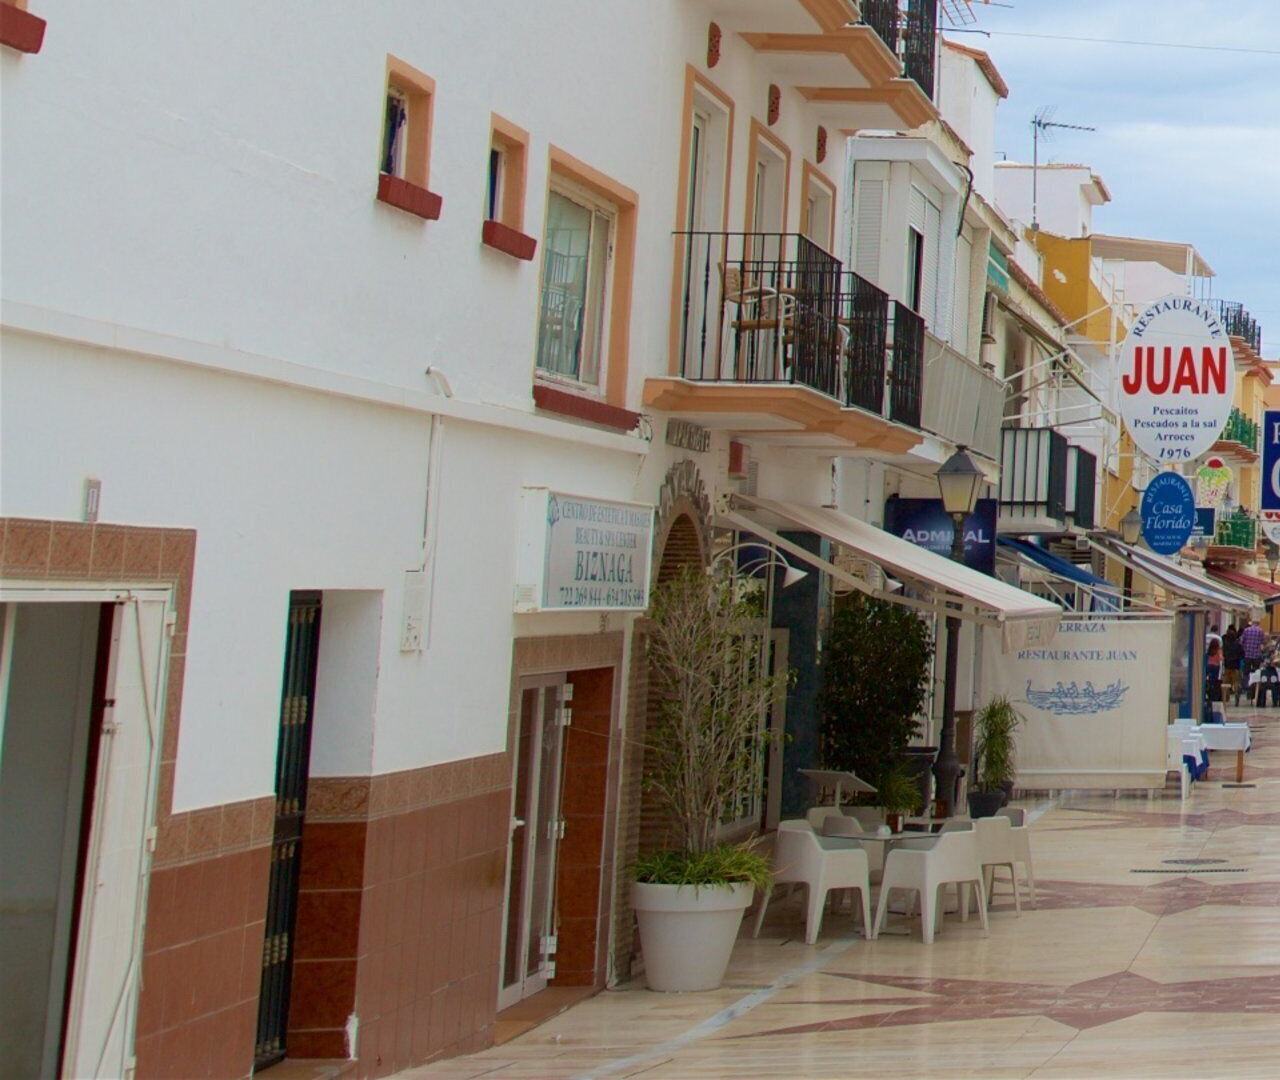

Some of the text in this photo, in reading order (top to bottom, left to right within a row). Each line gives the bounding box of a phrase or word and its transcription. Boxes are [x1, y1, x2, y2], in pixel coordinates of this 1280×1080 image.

[1133, 298, 1222, 339] RESTAURANTE
[1122, 346, 1227, 395] JUAN
[1152, 406, 1199, 416] Pescaitos
[1134, 419, 1179, 429] Pescados
[1190, 419, 1200, 429] la
[1202, 419, 1217, 429] sal
[1154, 432, 1196, 442] Arroces
[1159, 447, 1191, 459] 1976
[1152, 501, 1183, 514] Casa
[1146, 514, 1191, 530] Florido
[902, 528, 990, 544] ADMIAL
[575, 550, 633, 583] BIZNAGA
[1058, 622, 1107, 632] ERRAZA
[1018, 649, 1137, 661] RESTAURANTE JUAN
